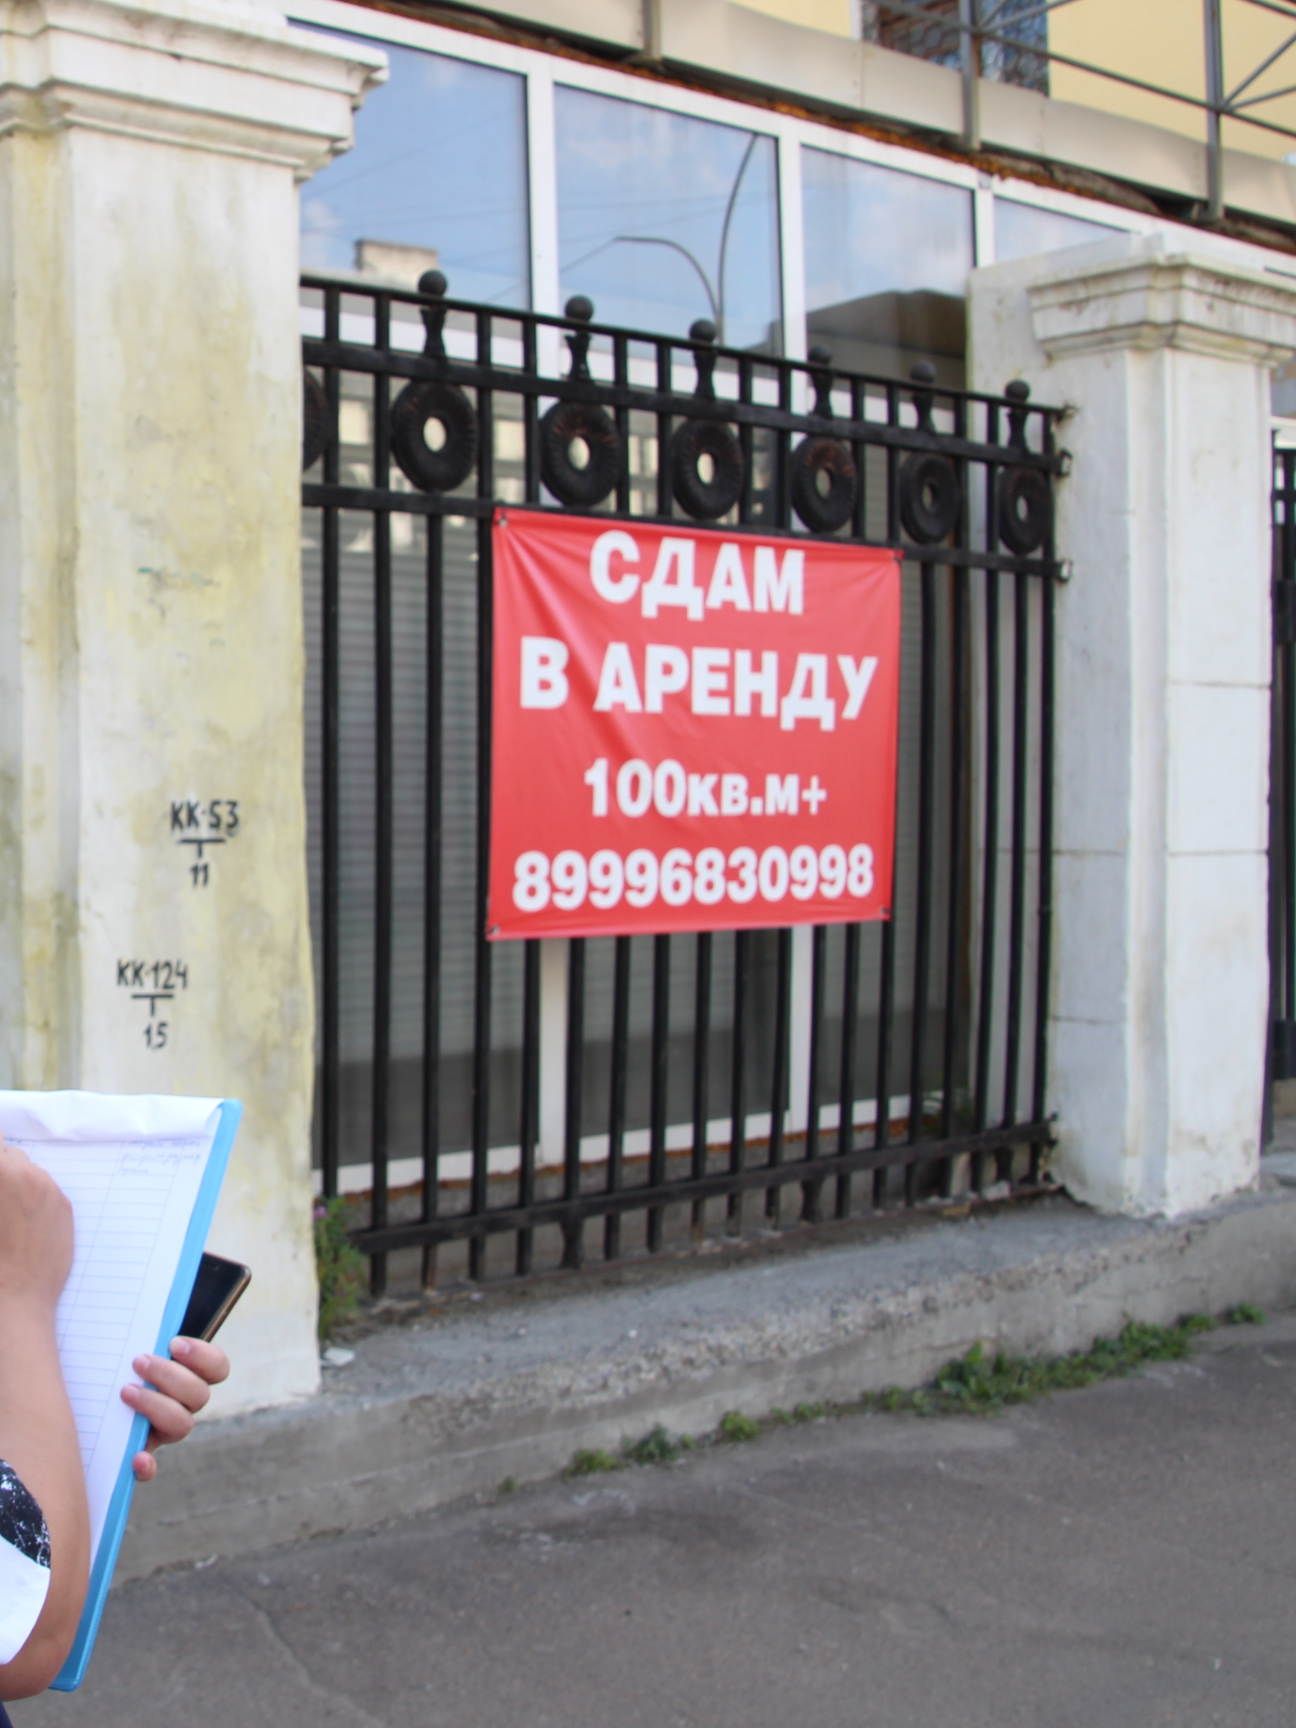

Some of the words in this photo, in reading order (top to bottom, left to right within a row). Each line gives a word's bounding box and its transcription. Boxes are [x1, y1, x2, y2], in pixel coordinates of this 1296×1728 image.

[589, 530, 805, 621] СДАМ
[520, 636, 570, 709] В
[593, 641, 878, 731] АРЕНДУ
[190, 863, 209, 888] 11
[512, 843, 874, 912] 89996830998
[143, 1021, 168, 1050] 15
